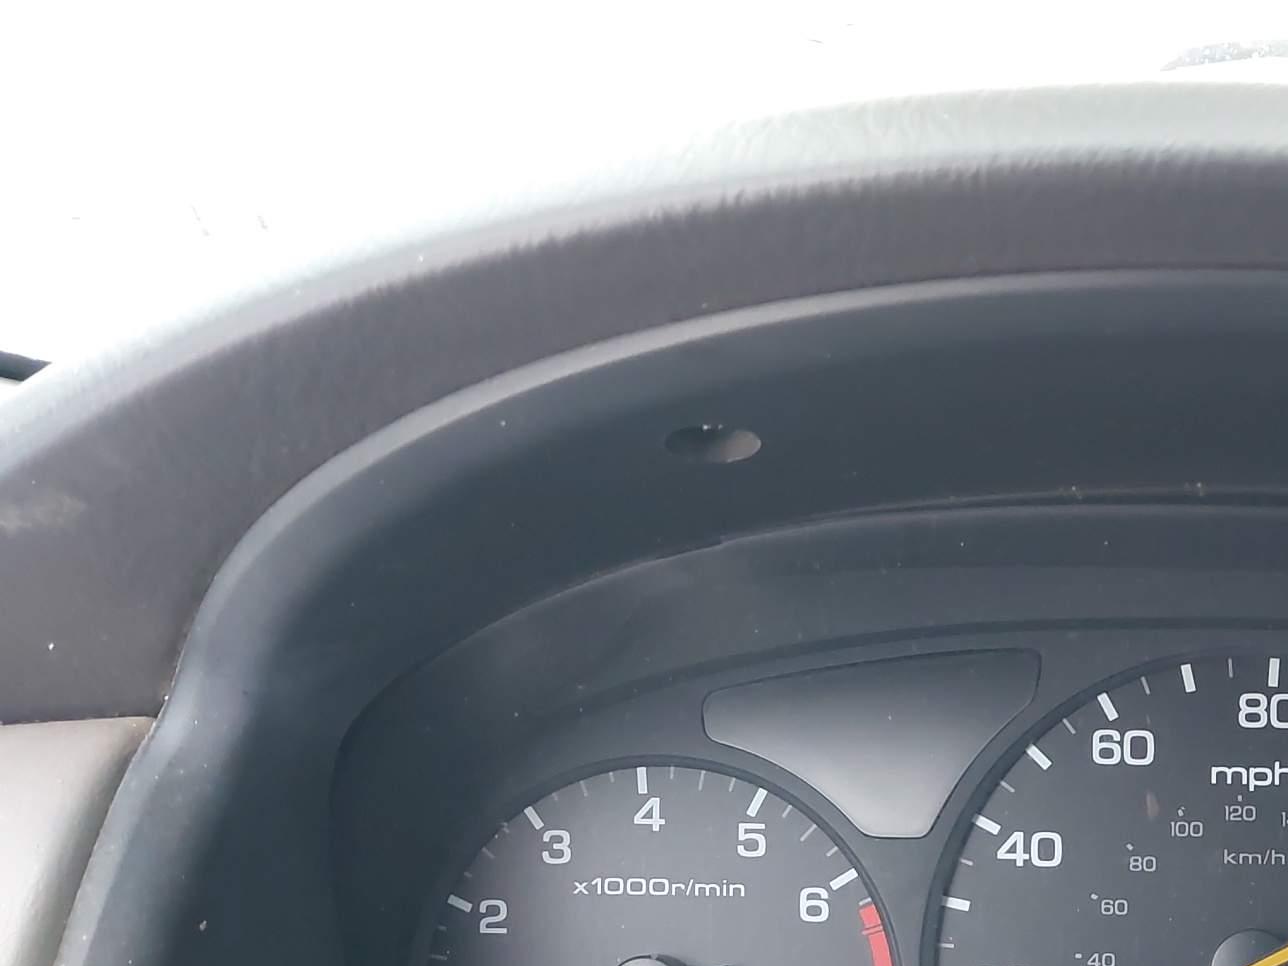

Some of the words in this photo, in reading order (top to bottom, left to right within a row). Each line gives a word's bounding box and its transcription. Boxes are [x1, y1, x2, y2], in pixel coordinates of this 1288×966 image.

[1092, 730, 1154, 765] 60
[633, 797, 666, 831] 4
[1170, 821, 1203, 837] 100
[1225, 805, 1256, 821] 120
[542, 829, 571, 864] 3
[736, 823, 766, 858] 5
[997, 832, 1062, 867] 40
[1223, 849, 1286, 865] km/h
[1129, 856, 1156, 872] 80
[573, 877, 746, 897] x1000r/min
[479, 899, 507, 934] 2
[799, 887, 829, 922] 6
[1101, 900, 1128, 915] 60
